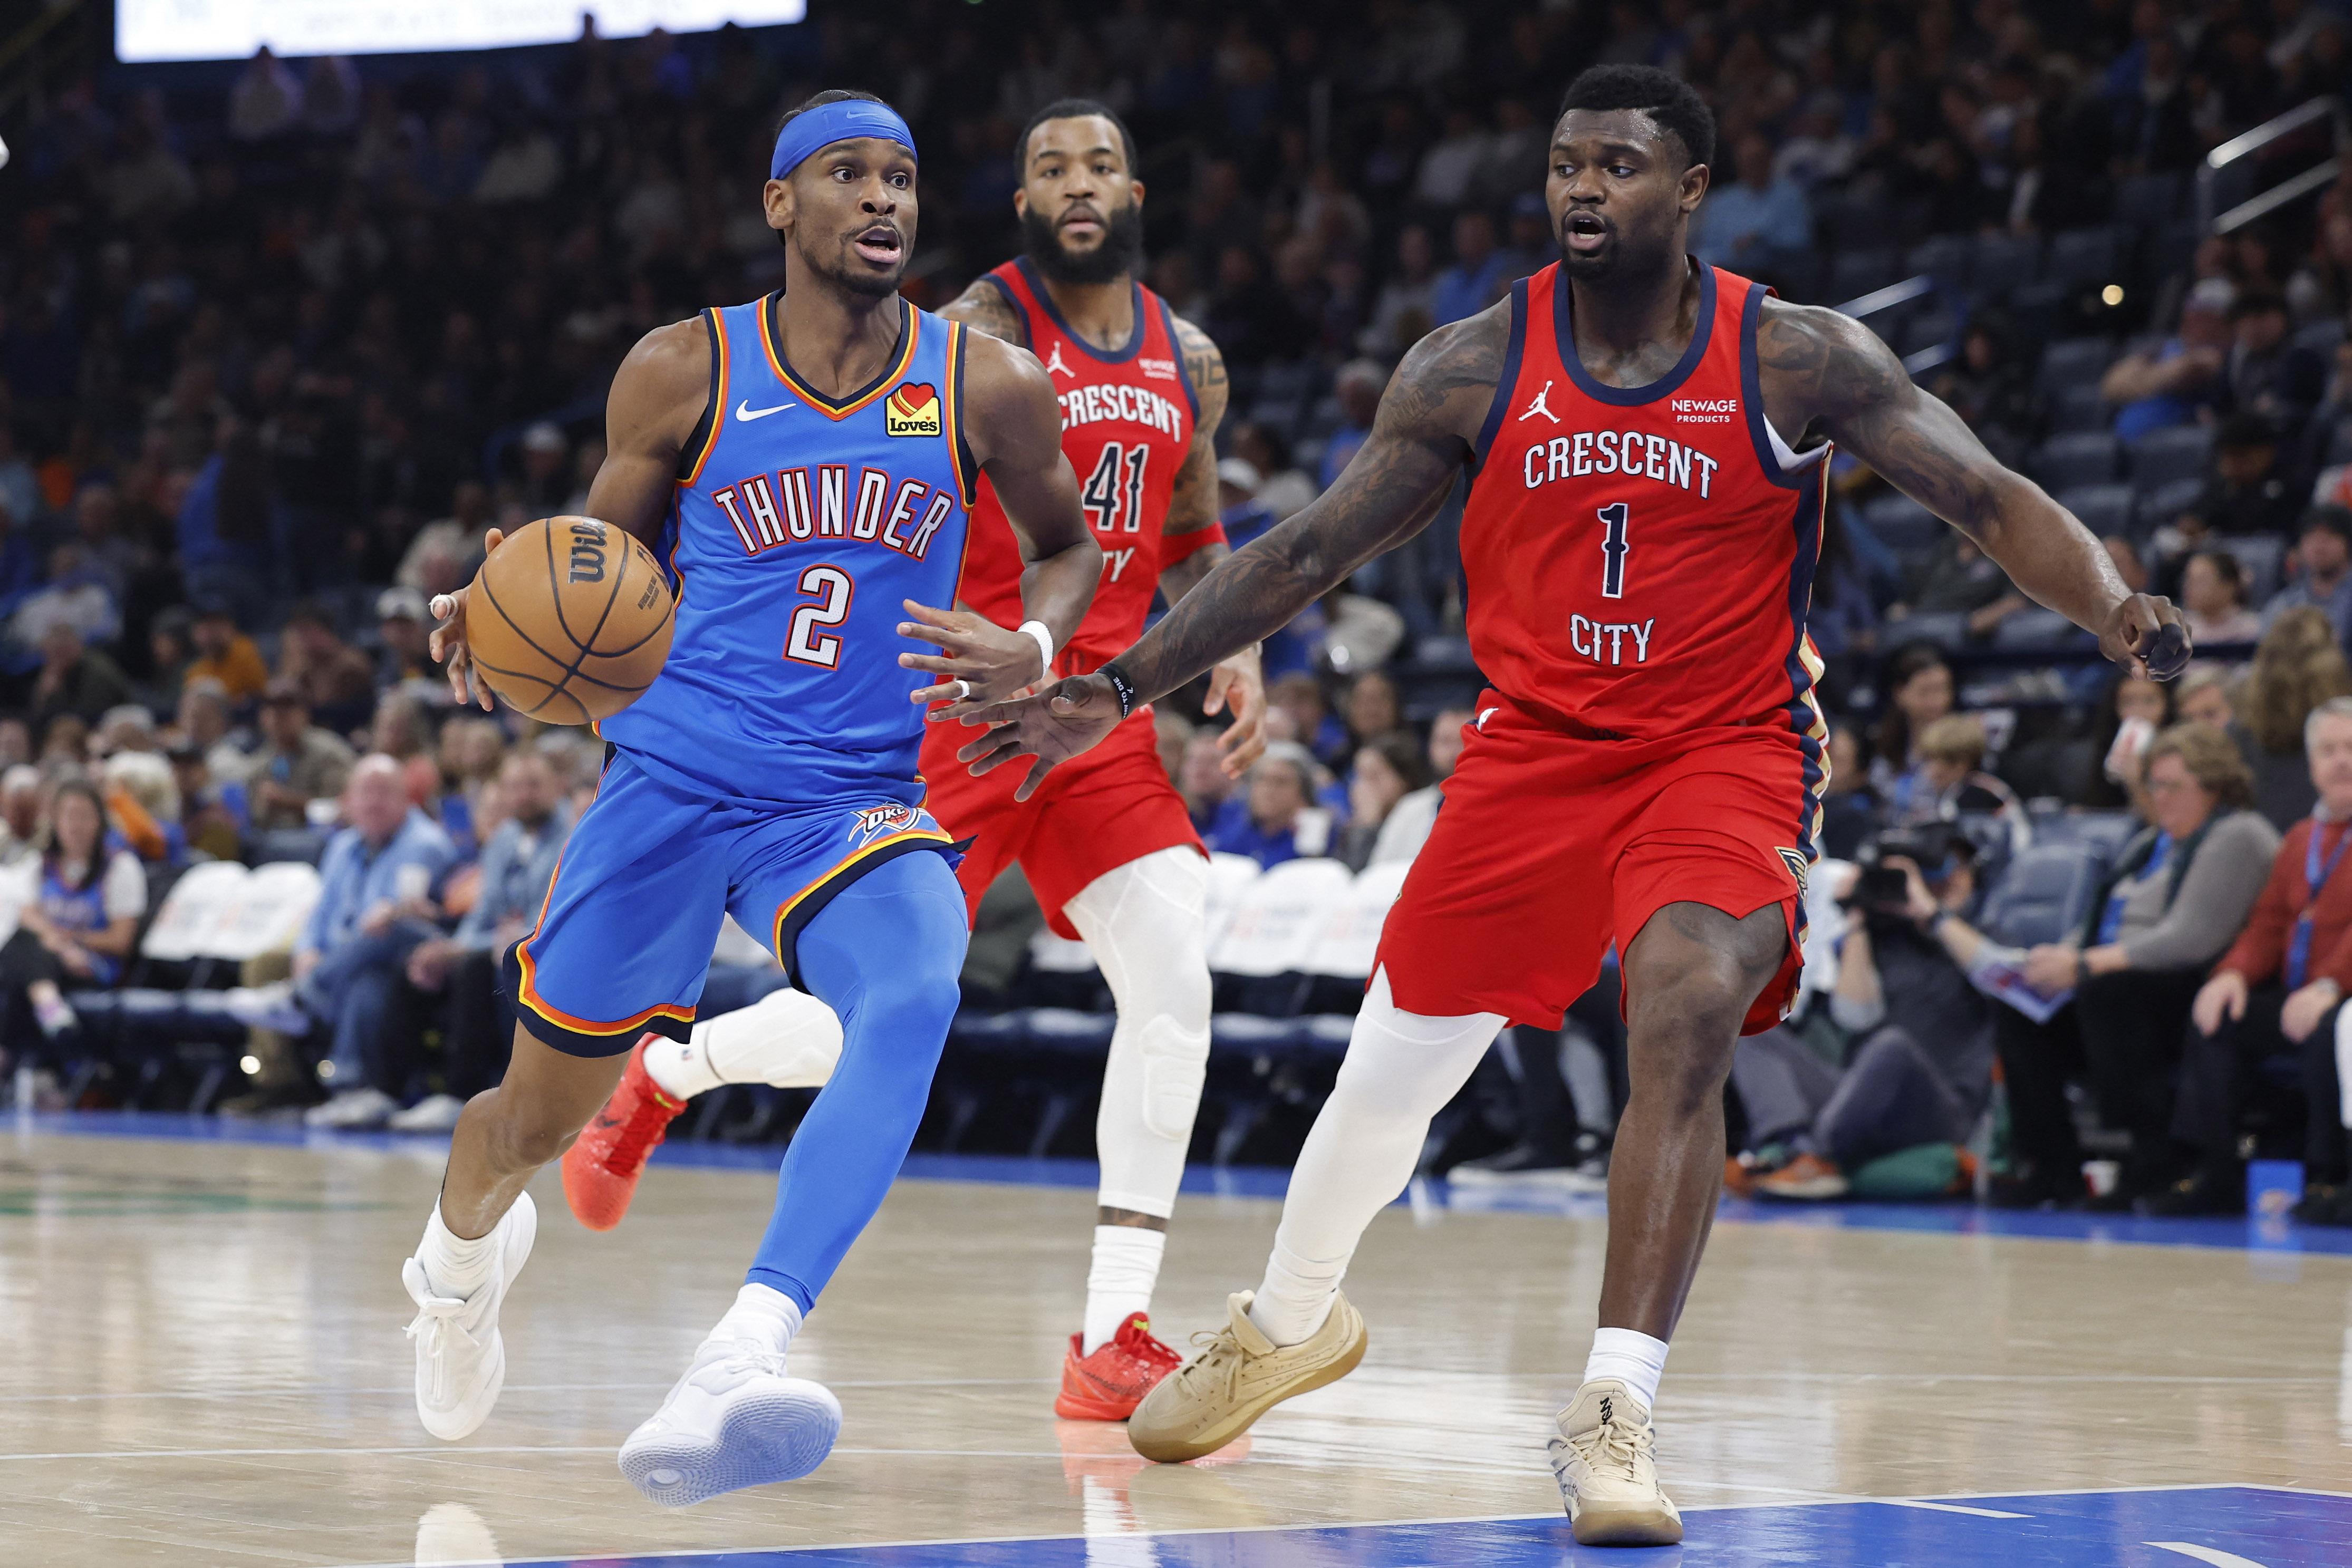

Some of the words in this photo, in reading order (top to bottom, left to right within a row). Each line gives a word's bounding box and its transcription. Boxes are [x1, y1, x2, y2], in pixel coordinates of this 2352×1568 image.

[1672, 399, 1737, 412] NEWAGE
[1082, 441, 1149, 533] 41
[1524, 430, 1718, 499] CRESCENT
[711, 464, 954, 563] THUNDER
[1597, 502, 1630, 599] 1
[782, 564, 855, 671] 2
[1570, 613, 1655, 665] CITY
[1113, 676, 1124, 691] DIE
[1121, 692, 1128, 703] TO
[866, 808, 905, 832] OKC
